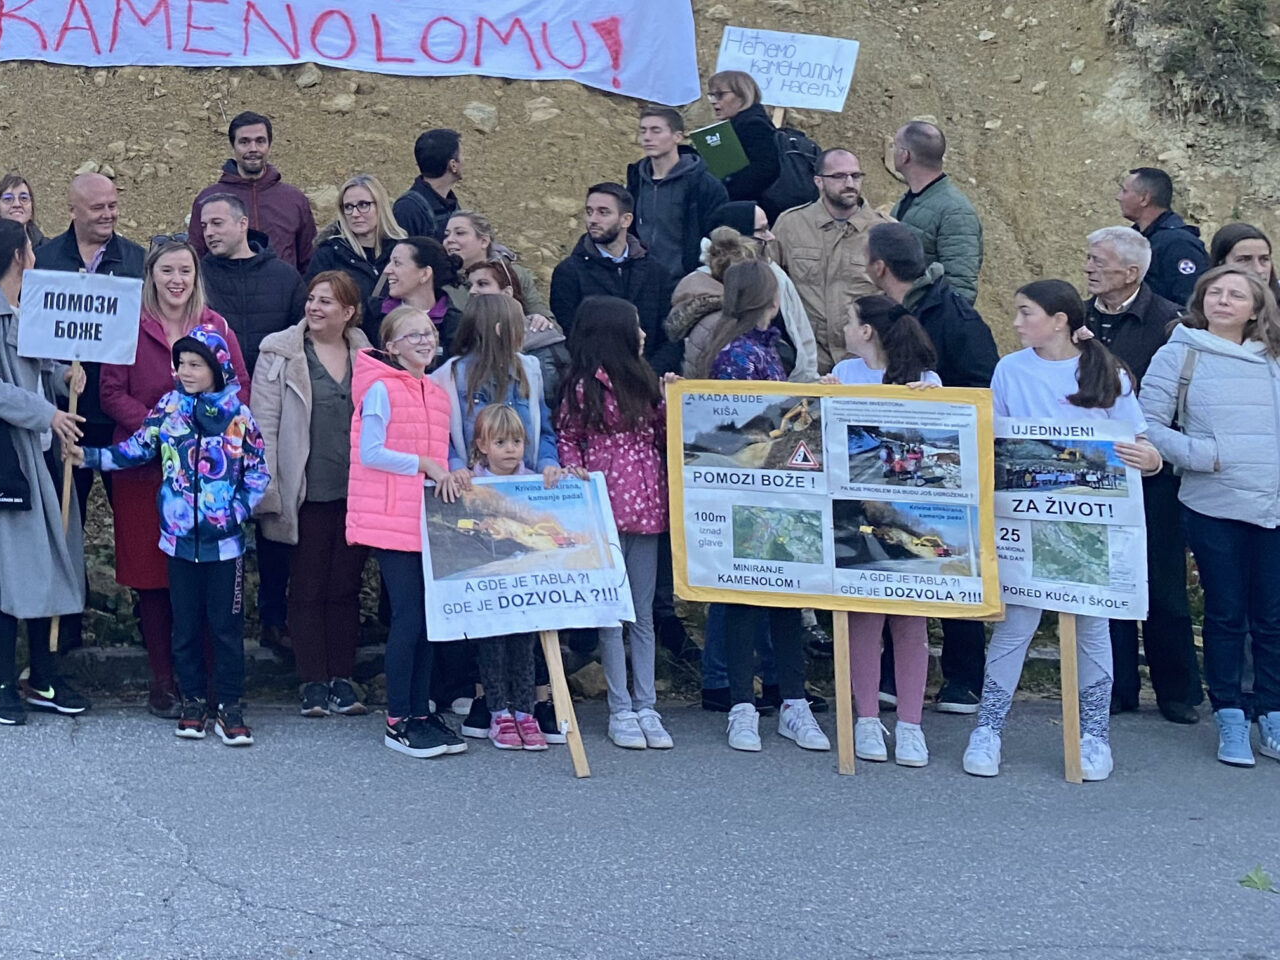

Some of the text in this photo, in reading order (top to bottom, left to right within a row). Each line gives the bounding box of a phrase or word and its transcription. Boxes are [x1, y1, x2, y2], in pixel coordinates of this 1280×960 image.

[725, 28, 797, 59] Нећемо
[43, 291, 118, 316] ПОМОЗИ
[54, 320, 103, 341] БОЖЕ
[688, 393, 763, 404] A KADA BUDE
[712, 406, 739, 416] KIŠA
[1011, 424, 1095, 437] UJEDINJENI
[693, 471, 816, 489] POMOZI BOŽE !
[1012, 496, 1114, 518] ZA ŽIVOT!
[694, 511, 727, 523] 100m
[699, 526, 722, 535] iznad
[1000, 527, 1021, 542] 25
[697, 538, 724, 548] glave
[733, 563, 785, 575] MINIRANJE
[464, 581, 475, 593] A
[477, 579, 508, 591] GDE
[511, 577, 529, 588] JE
[531, 572, 574, 586] TABLA
[717, 574, 794, 589] KAMENOLOM
[859, 573, 868, 581] A
[870, 573, 894, 582] GDE
[896, 574, 910, 584] JE
[913, 576, 948, 586] TABLA
[840, 585, 864, 595] GDE
[866, 587, 880, 596] JE
[884, 587, 955, 601] DOZVOLA
[1002, 585, 1042, 599] PORED
[1081, 596, 1086, 605] I
[442, 601, 474, 615] GDE
[476, 598, 494, 611] JE
[497, 589, 587, 609] DOZVOLA
